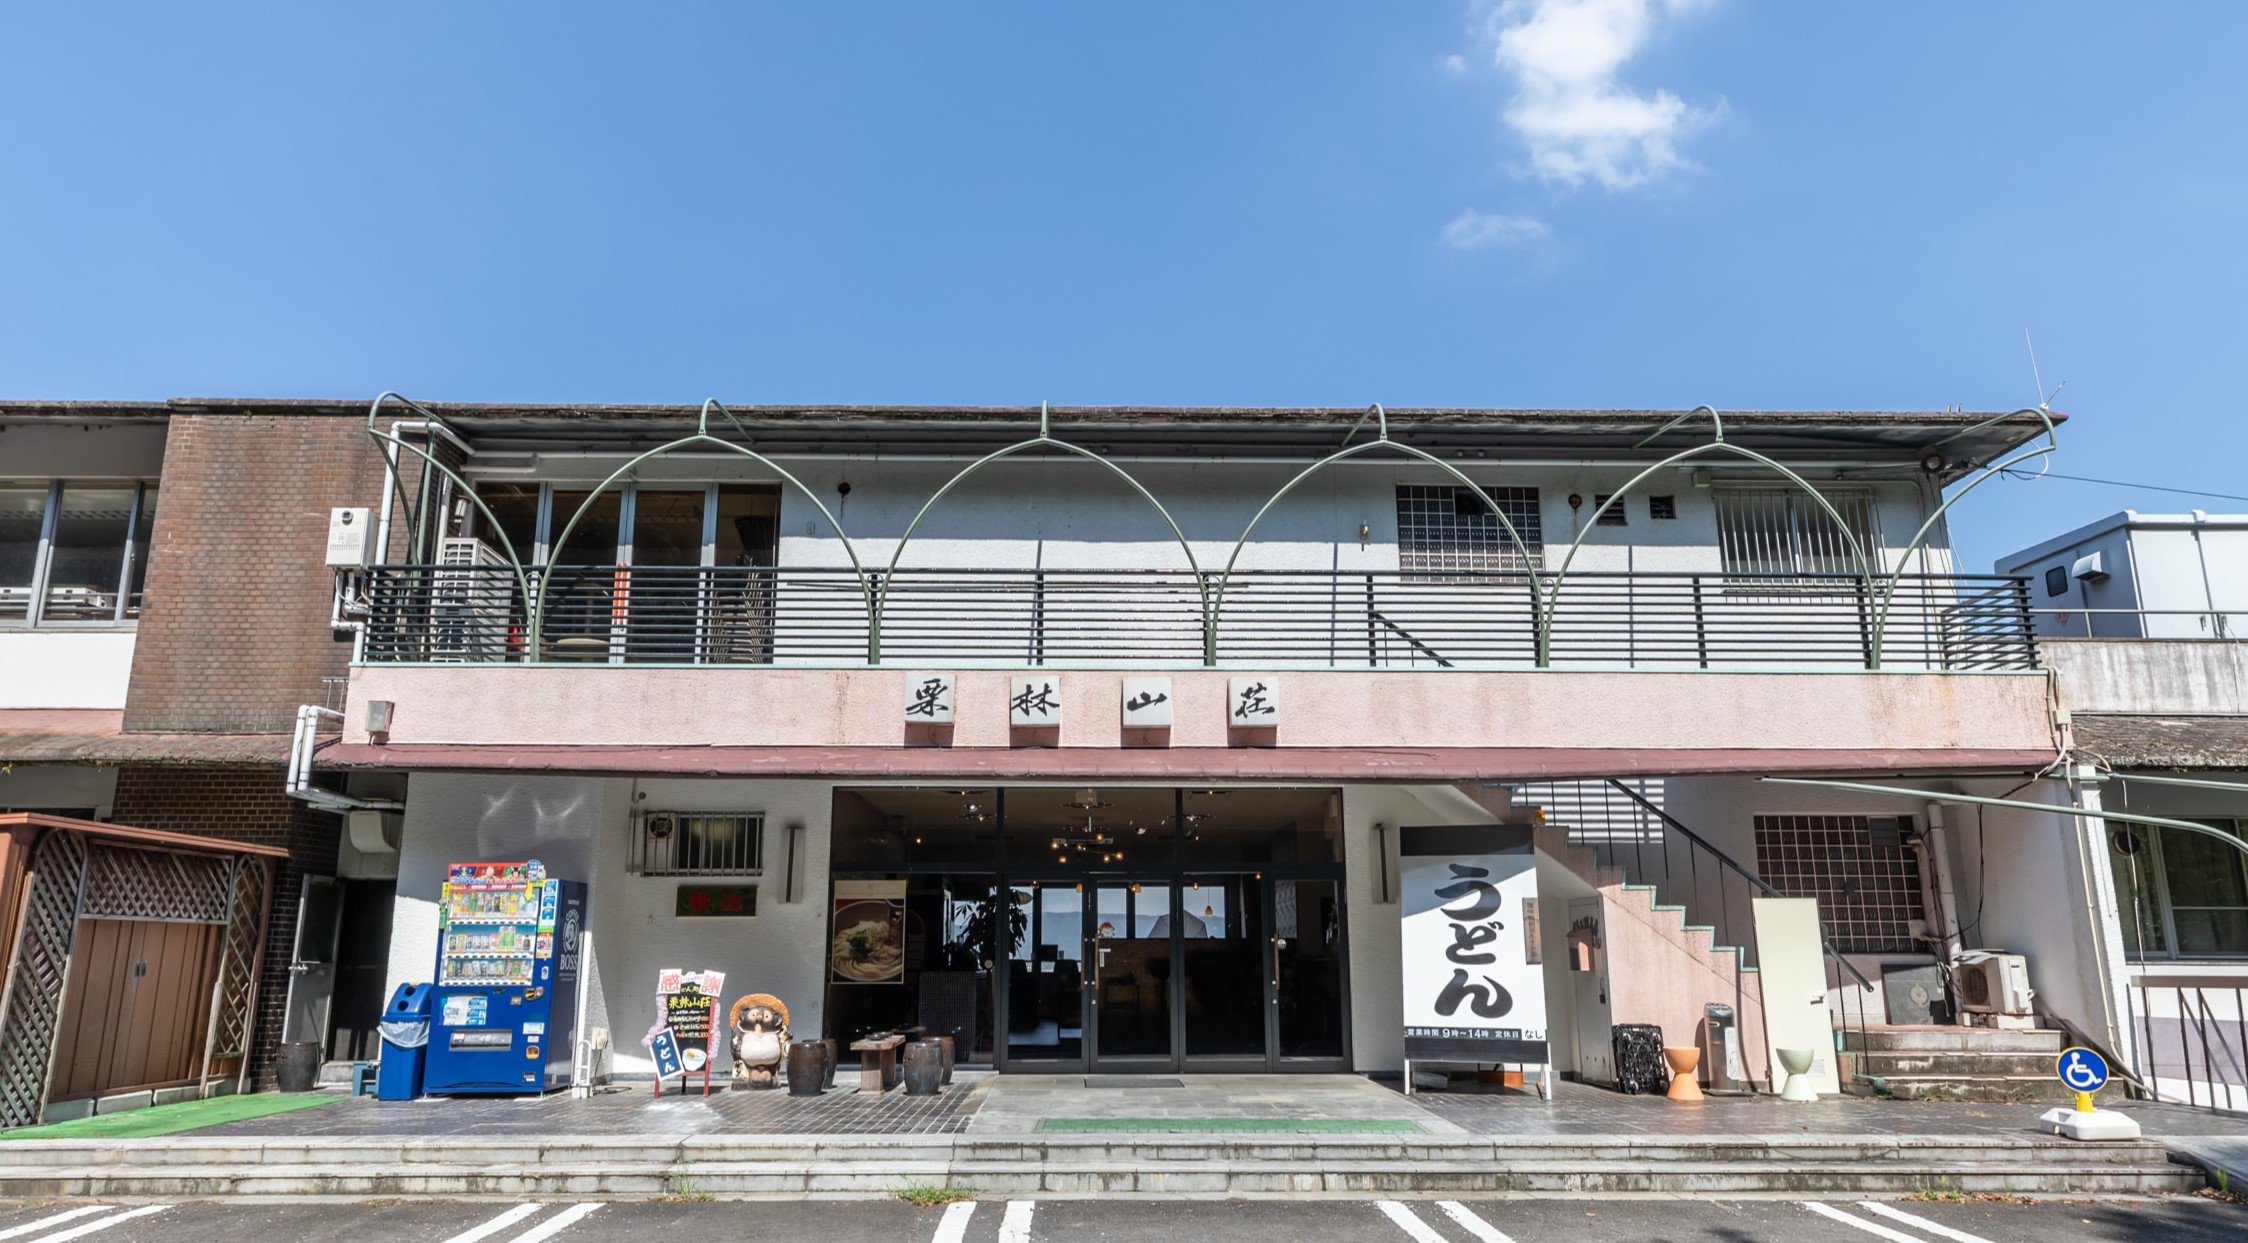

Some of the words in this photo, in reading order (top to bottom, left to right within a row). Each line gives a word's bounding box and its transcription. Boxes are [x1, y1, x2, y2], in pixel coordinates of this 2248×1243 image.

[905, 678, 1275, 718] 栗林山荘
[1433, 863, 1514, 1019] うどん
[559, 953, 579, 970] BOSS
[1406, 1027, 1440, 1038] 営業時間
[1494, 1029, 1520, 1039] 定休日
[1523, 1029, 1544, 1040] なし
